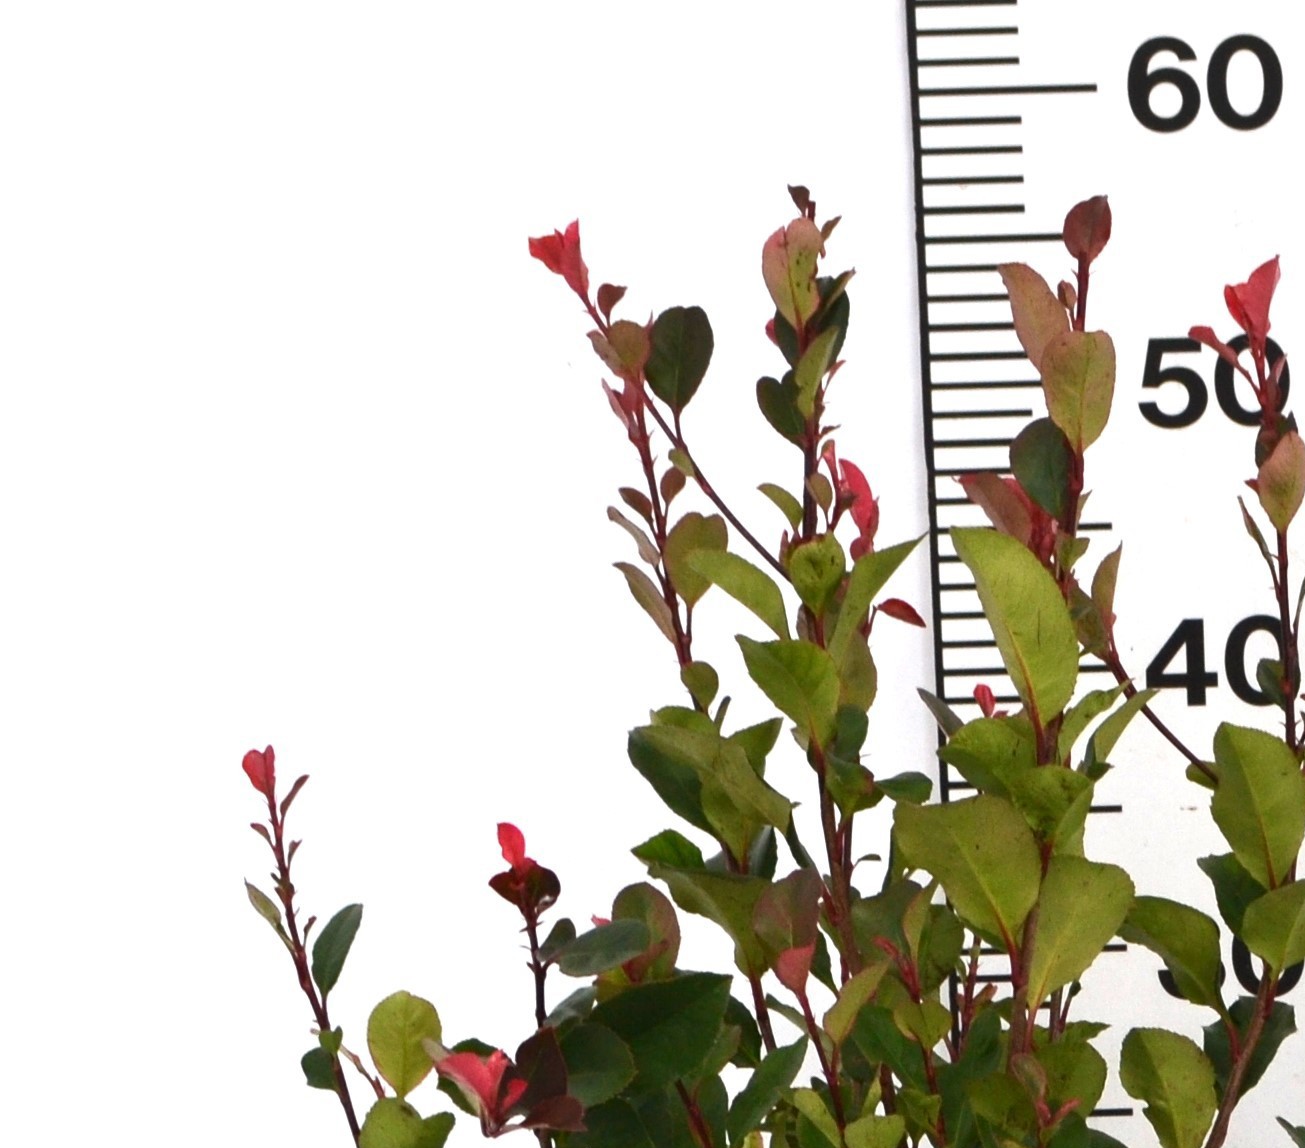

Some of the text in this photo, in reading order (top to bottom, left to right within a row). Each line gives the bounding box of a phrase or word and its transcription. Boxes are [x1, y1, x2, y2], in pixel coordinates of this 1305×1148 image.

[1127, 34, 1284, 133] 60
[1138, 334, 1290, 429] 50
[1145, 614, 1300, 706] 40
